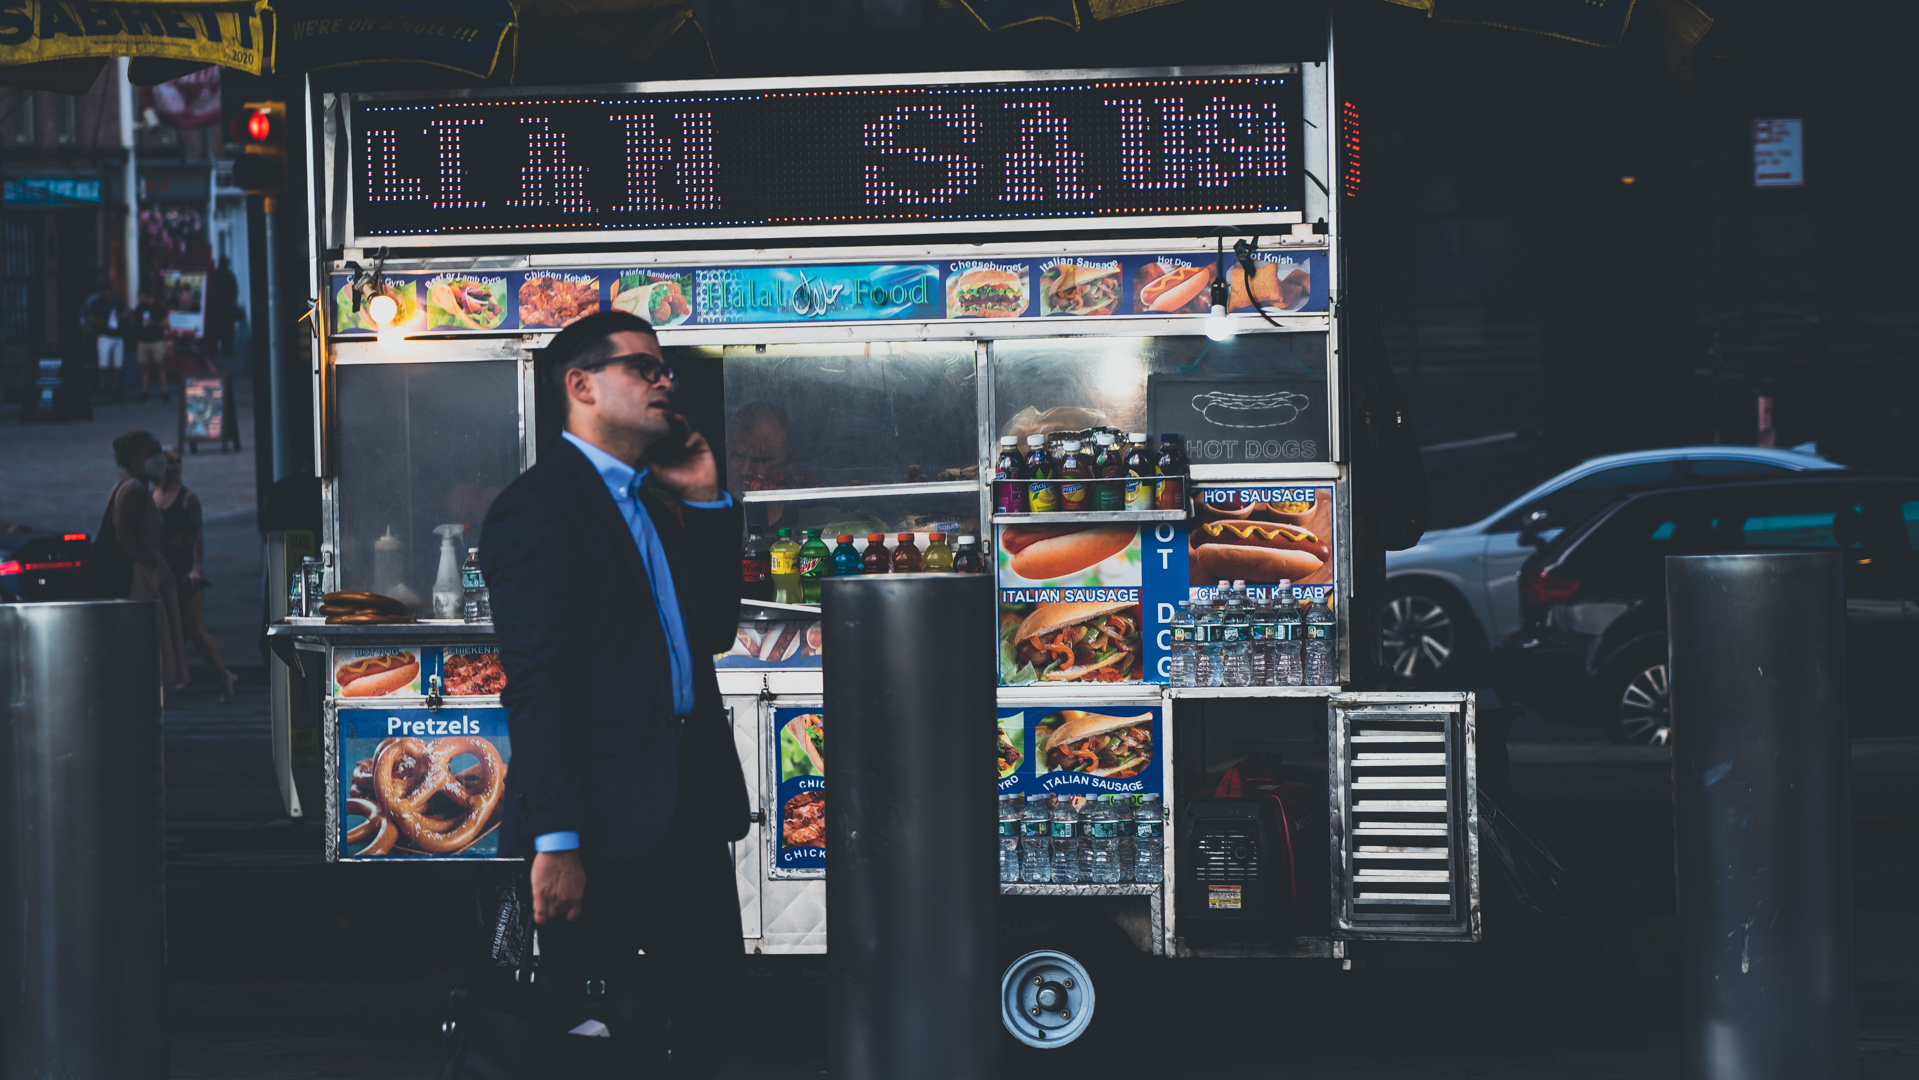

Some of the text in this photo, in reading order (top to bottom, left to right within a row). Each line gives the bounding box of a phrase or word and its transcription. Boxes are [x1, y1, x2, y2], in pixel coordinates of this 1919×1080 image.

[0, 0, 255, 50] SABRETT
[293, 19, 478, 43] WE'RE ON A ROLL !!!
[232, 50, 254, 65] 2020
[1039, 256, 1119, 272] Italian Sausage
[1157, 255, 1192, 269] Hot Dog
[1250, 252, 1293, 264] ot Knish
[620, 268, 681, 280] Falafel Sandwich
[950, 260, 1022, 273] Cheeseburger
[385, 277, 405, 288] Gyro
[424, 273, 445, 288] Beef
[458, 272, 480, 283] Lamb
[482, 276, 501, 286] Gyro
[524, 270, 591, 283] Chicken Kebab
[706, 273, 786, 309] Halal
[853, 273, 929, 308] Food
[1186, 439, 1317, 459] HOT DOGS
[1204, 488, 1316, 503] HOT SAUSAGE
[1155, 522, 1175, 570] OT
[1001, 588, 1139, 603] ITALIAN SAUSAGE
[1198, 586, 1325, 600] CHEN KBAB
[355, 647, 399, 657] HOT DOG
[448, 647, 491, 656] CHICKEN
[387, 714, 480, 736] Pretzels
[798, 778, 825, 789] CHIC
[997, 775, 1019, 791] YRO
[1042, 774, 1144, 793] ITALIAN SAUSAGE
[1294, 813, 1315, 831] HONDA
[784, 850, 826, 862] CHICK
[491, 922, 507, 960] PREMIUM
